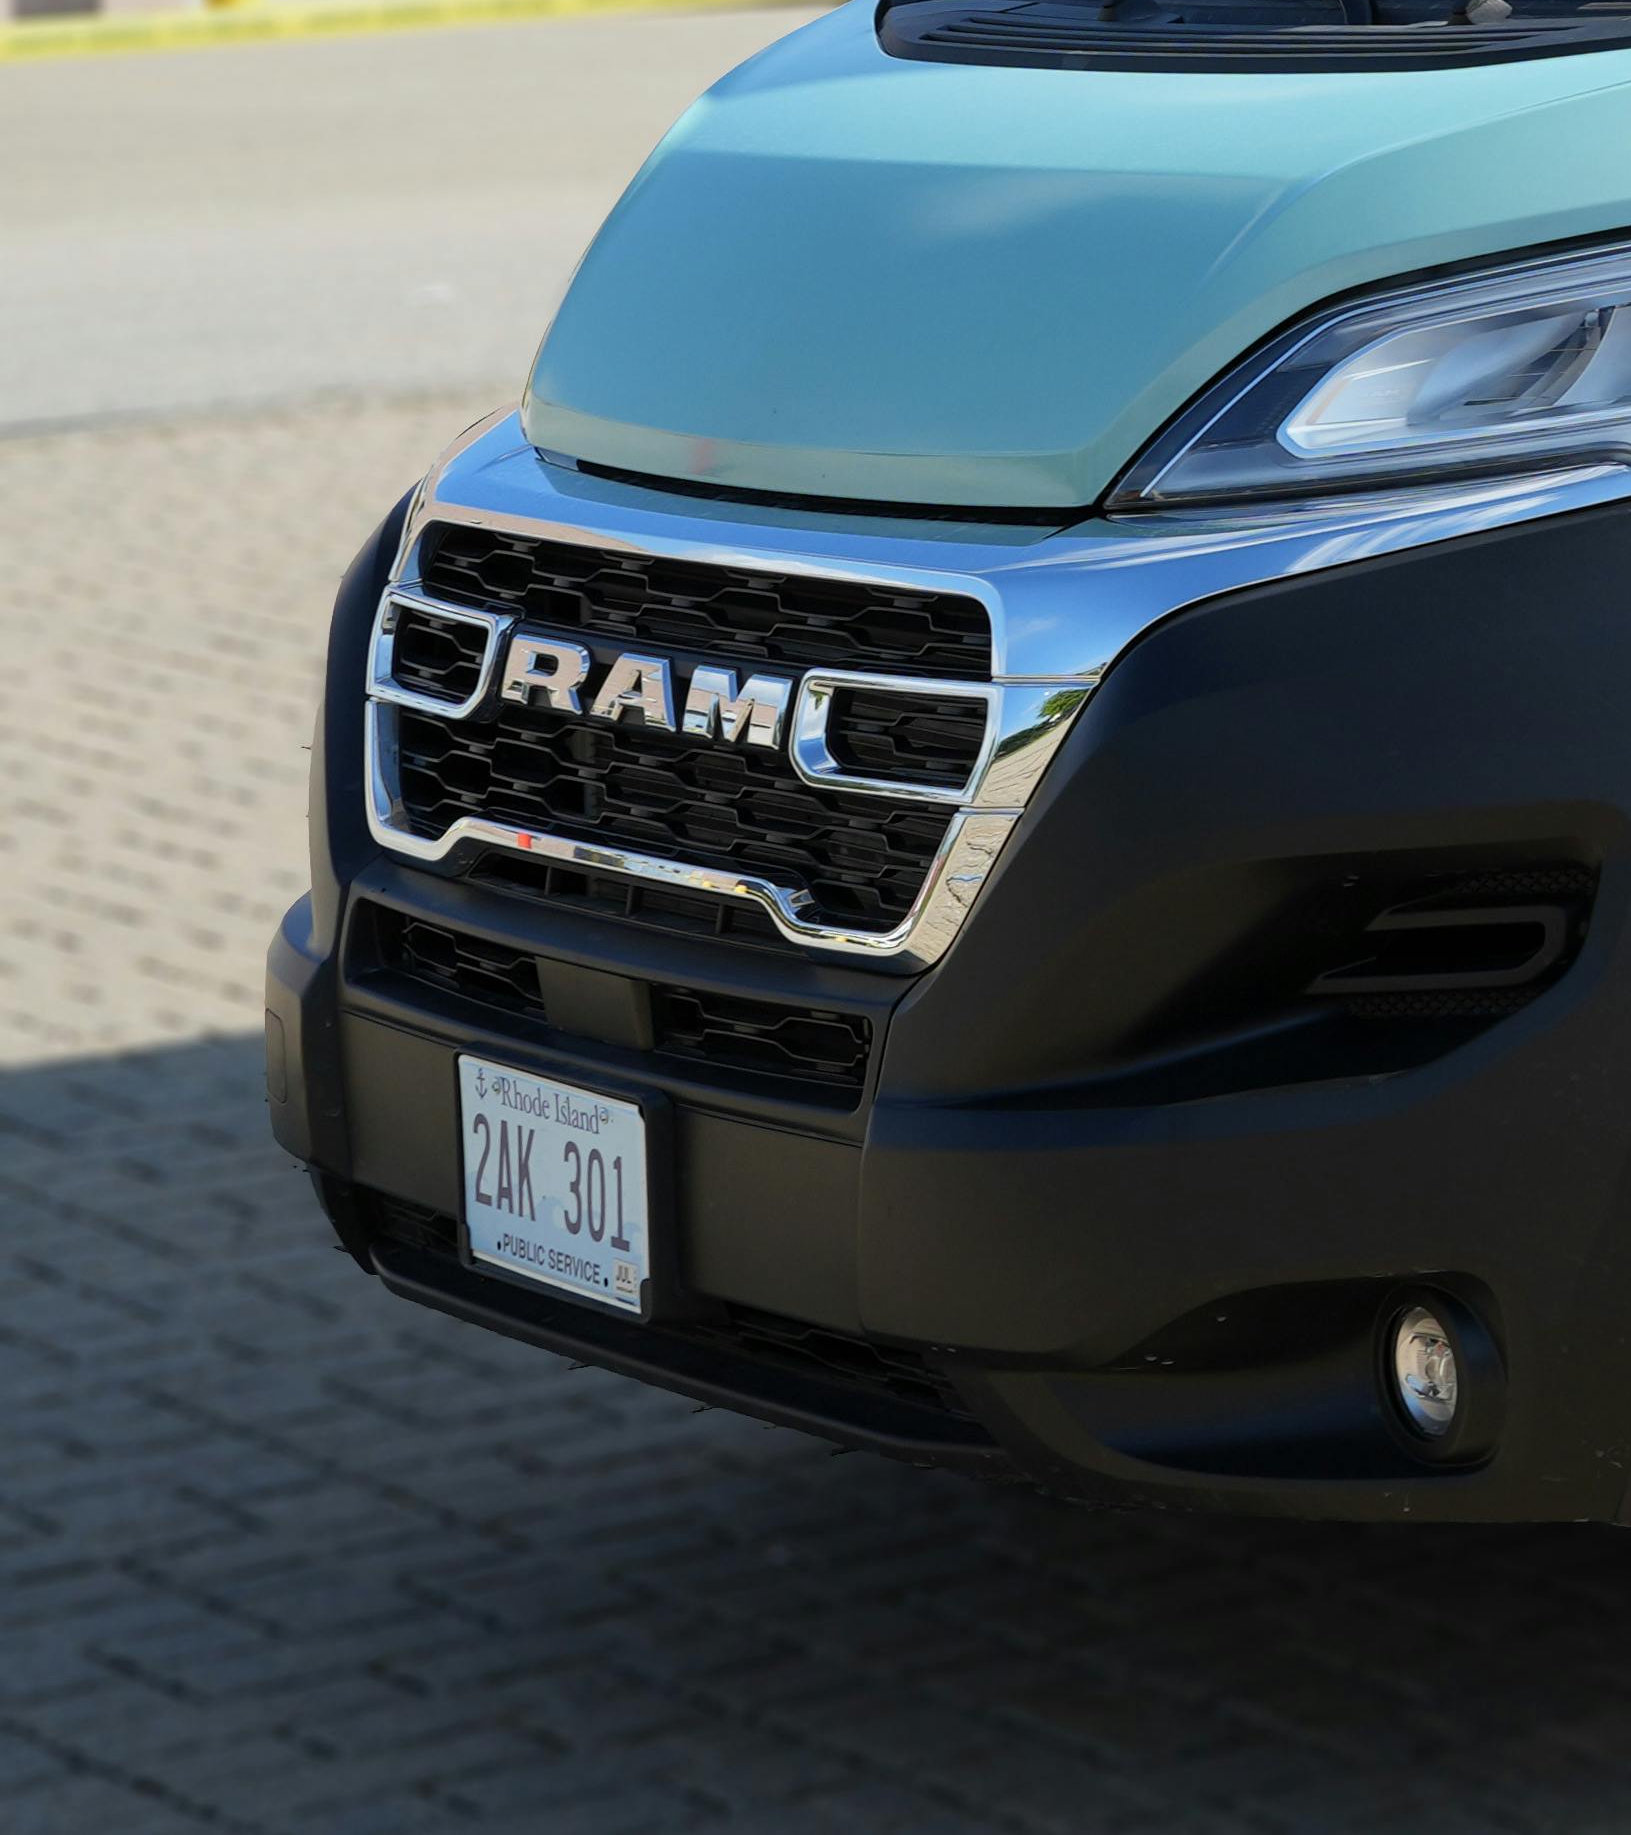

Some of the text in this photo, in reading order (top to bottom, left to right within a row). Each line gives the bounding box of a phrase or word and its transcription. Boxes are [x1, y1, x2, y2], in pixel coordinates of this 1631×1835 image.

[501, 633, 794, 751] RAM
[501, 1077, 601, 1135] Rhode Island
[473, 1113, 630, 1252] 2AK 301
[503, 1232, 601, 1285] PUBLIC SERVICE
